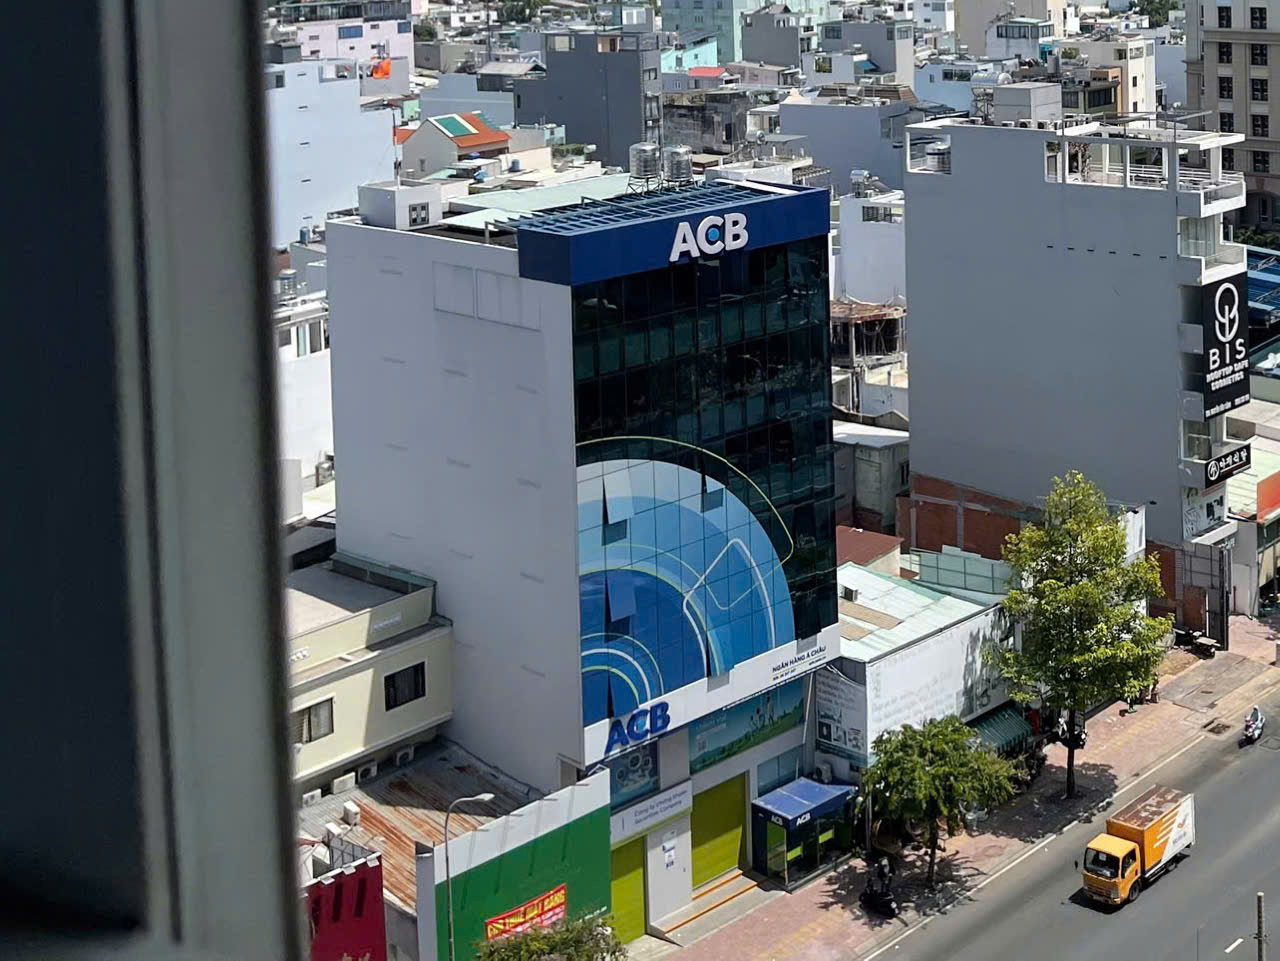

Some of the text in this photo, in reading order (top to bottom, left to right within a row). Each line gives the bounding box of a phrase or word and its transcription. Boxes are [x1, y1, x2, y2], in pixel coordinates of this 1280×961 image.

[669, 213, 749, 262] ACB
[1209, 338, 1246, 371] BIS
[604, 701, 671, 756] ACB
[770, 815, 783, 826] ACB
[796, 813, 811, 826] ACB
